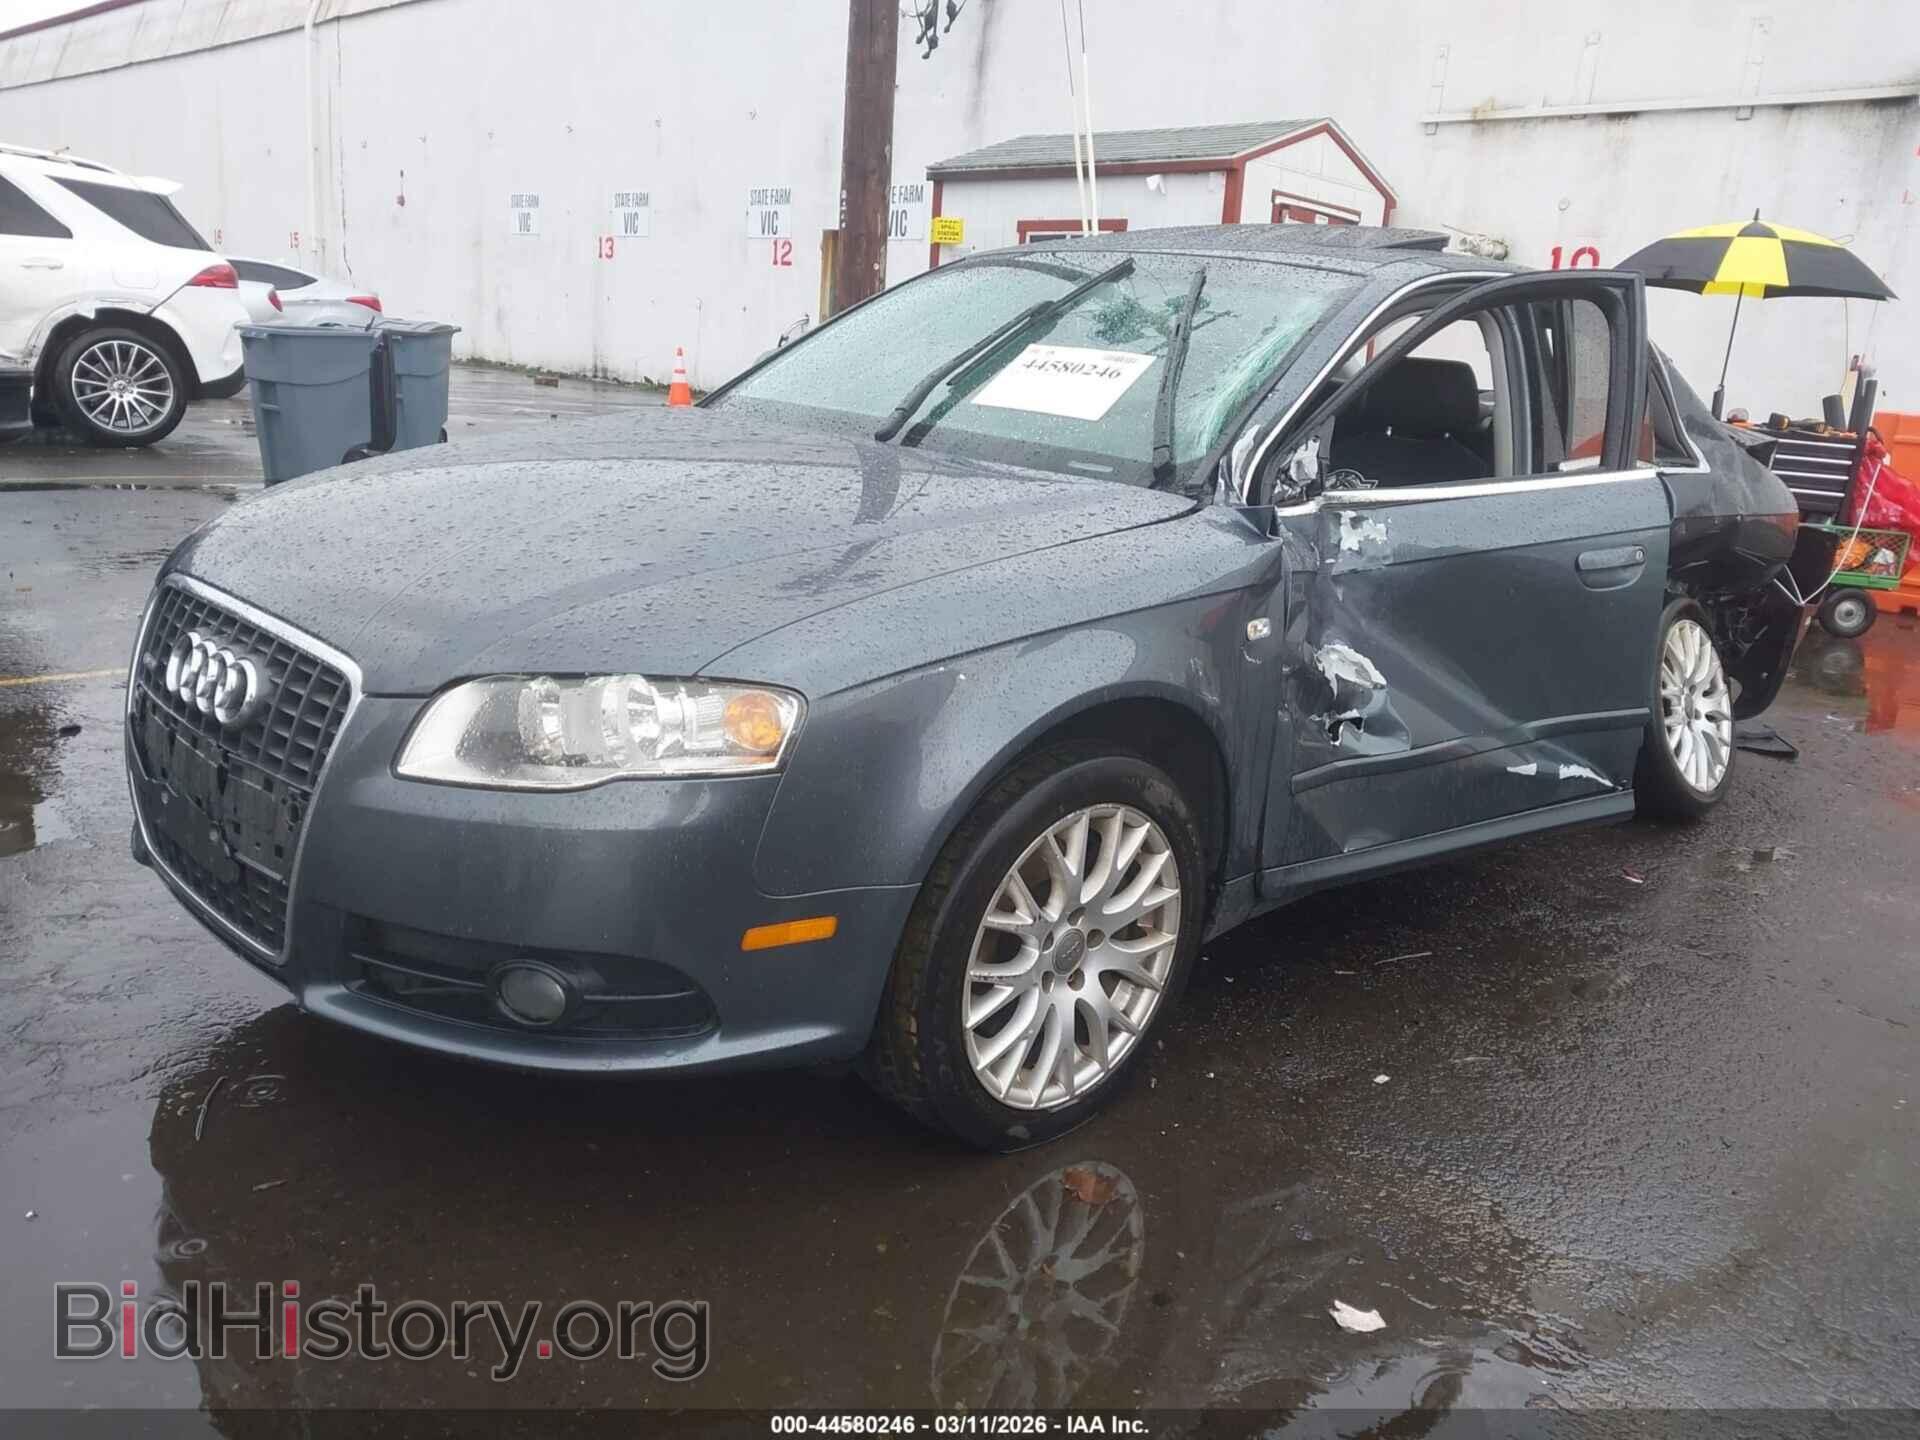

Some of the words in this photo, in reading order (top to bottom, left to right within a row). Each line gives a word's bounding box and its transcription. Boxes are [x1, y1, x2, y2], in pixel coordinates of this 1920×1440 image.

[614, 193, 631, 208] STATE
[631, 192, 649, 208] FARM
[750, 189, 769, 205] STATE
[770, 188, 790, 204] FARM
[899, 185, 924, 204] FARM
[518, 212, 531, 232] VIC
[623, 212, 639, 235] VIC
[760, 210, 779, 235] VIC
[888, 209, 908, 237] VIC
[598, 236, 615, 259] 13
[772, 240, 793, 266] 12
[1022, 359, 1122, 379] 44580246
